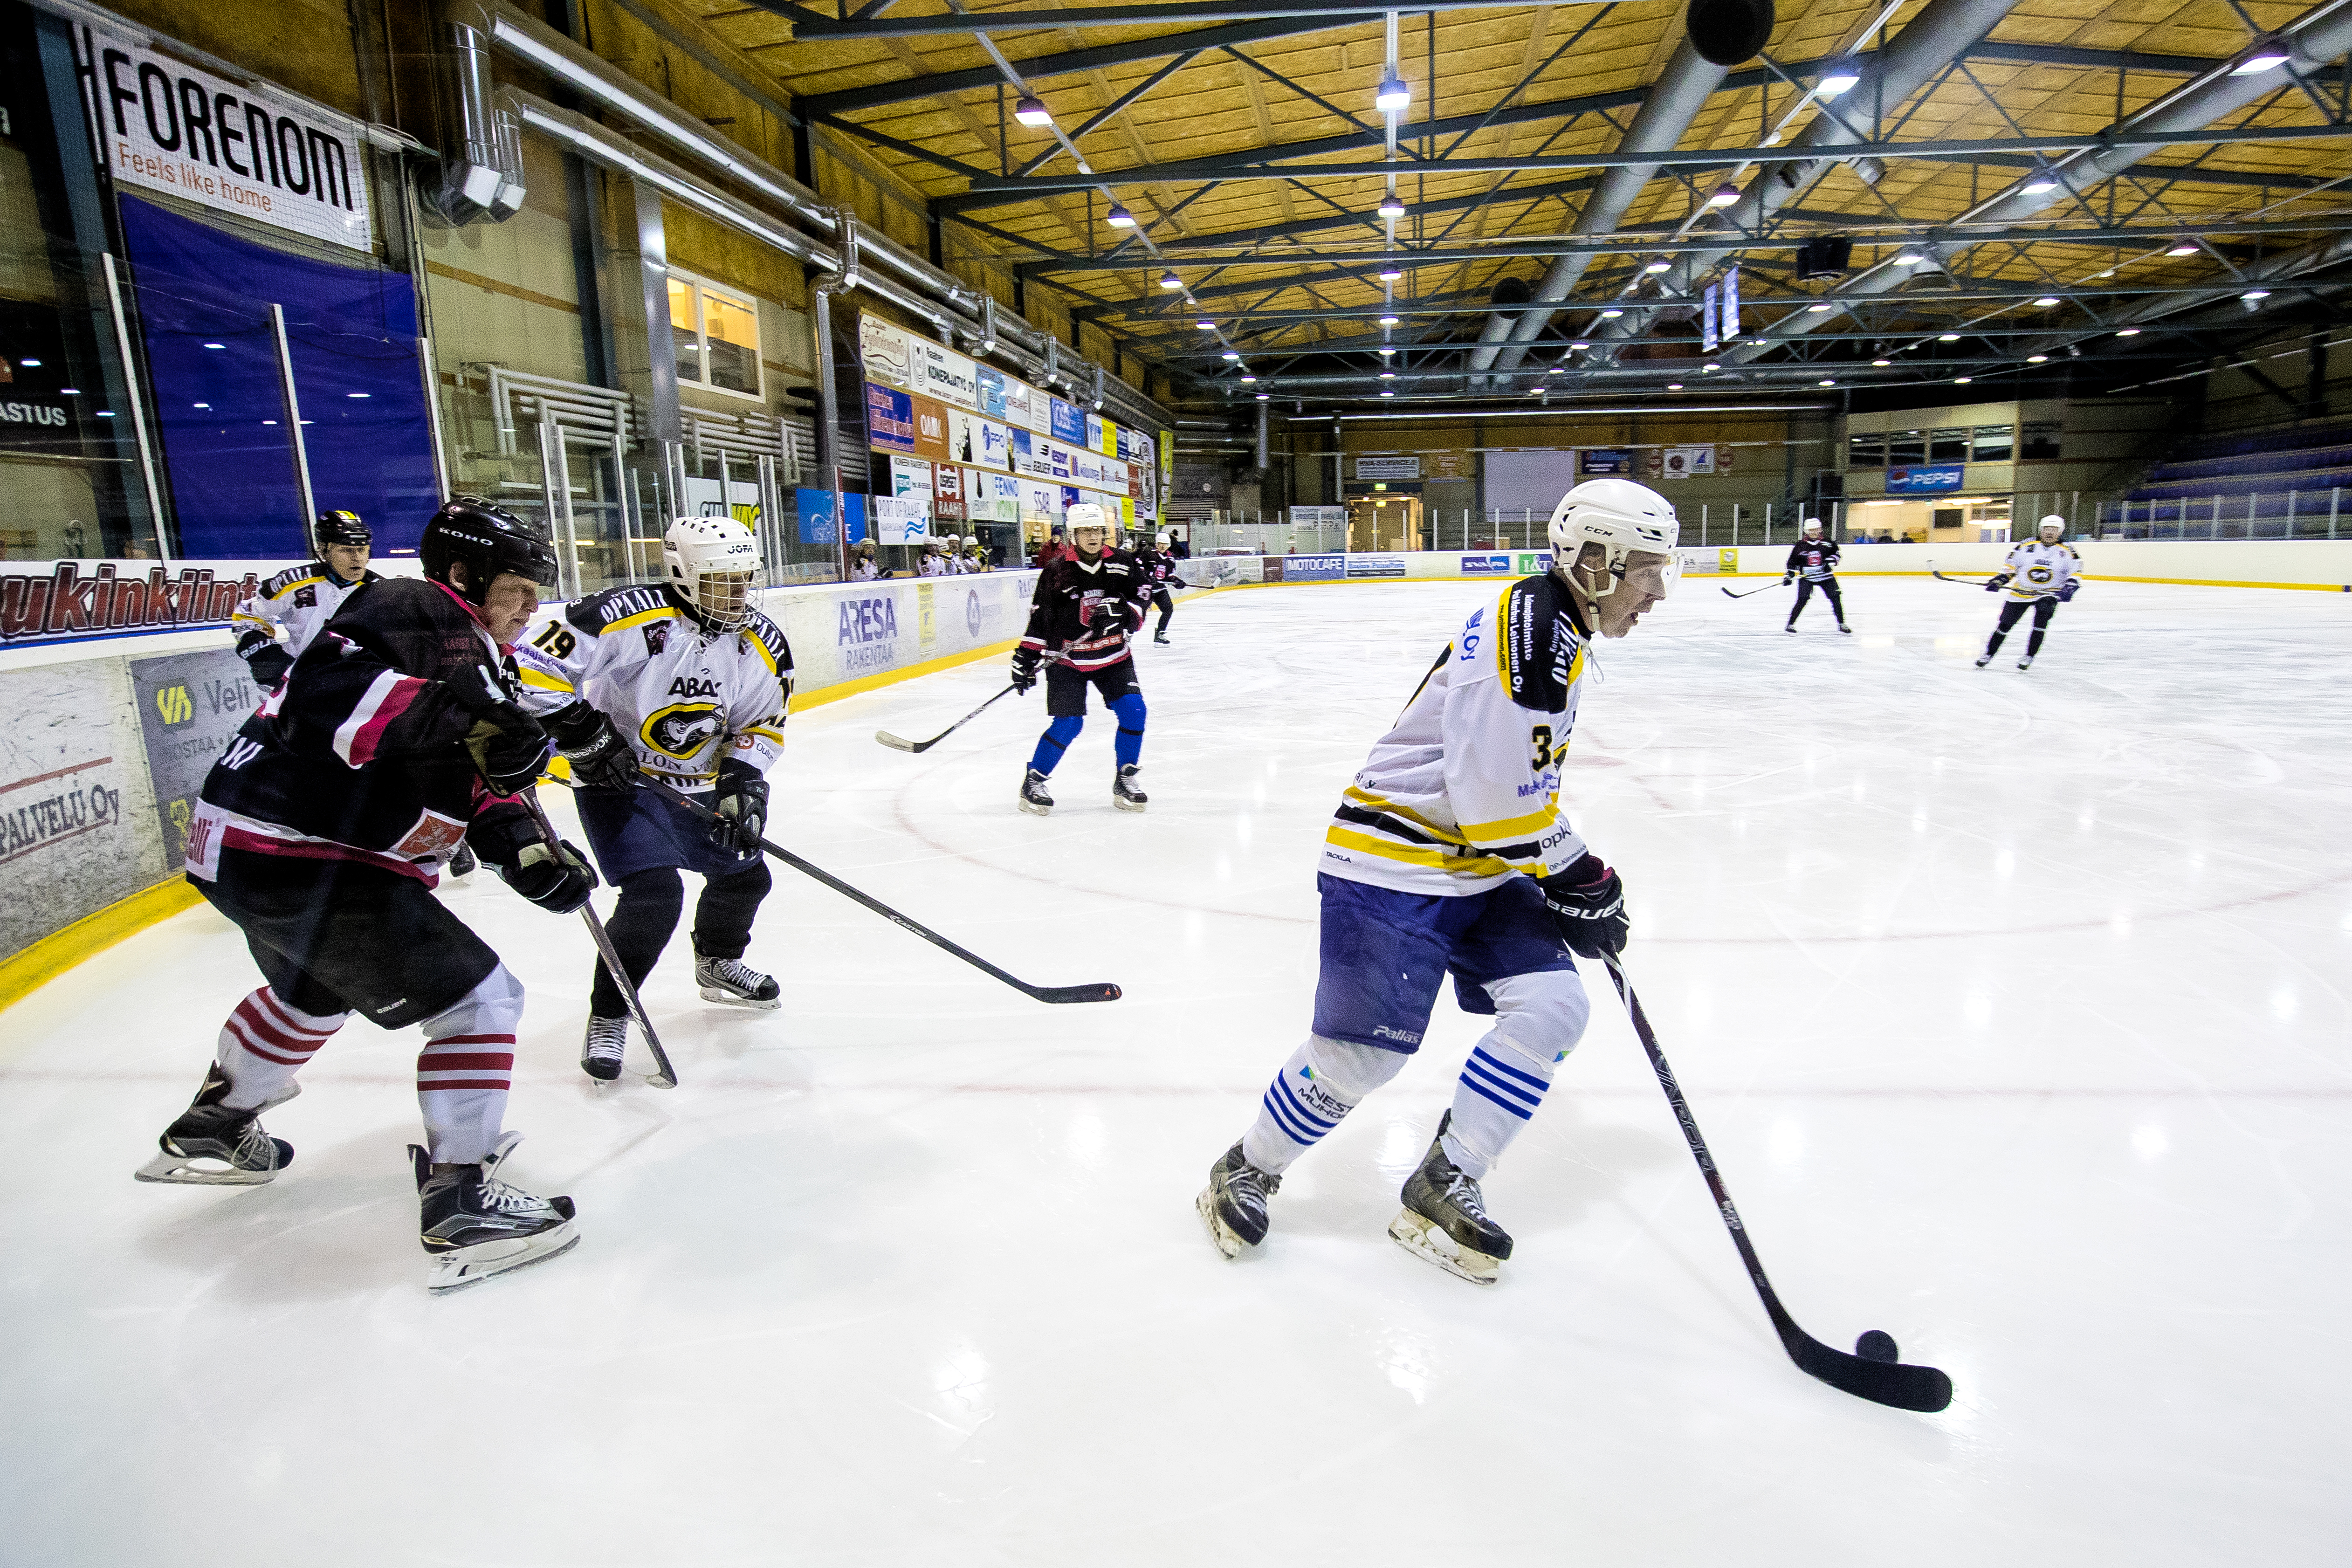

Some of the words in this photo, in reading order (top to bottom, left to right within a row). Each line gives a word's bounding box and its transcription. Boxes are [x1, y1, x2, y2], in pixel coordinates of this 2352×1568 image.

[103, 48, 354, 212] FORENOM
[117, 141, 176, 184] Feels
[185, 164, 214, 197] like
[220, 177, 272, 213] home
[995, 476, 1020, 497] FENNO
[1912, 472, 1962, 485] PEPSI
[439, 527, 493, 546] KOHO
[1584, 525, 1614, 537] CCM
[1287, 558, 1343, 571] MOTOCAFE
[600, 588, 670, 624] OPAALI
[1510, 598, 1521, 624] Markus
[839, 597, 898, 646] ARESA
[531, 619, 577, 660] 19
[1460, 635, 1480, 661] Oy
[1510, 625, 1521, 673] Leinonen
[204, 678, 251, 714] Veli
[1512, 675, 1523, 693] Oy
[1531, 724, 1553, 772] 3
[90, 784, 120, 825] Oy
[1326, 851, 1352, 863] TACKLA
[1372, 1025, 1419, 1045] Pallas
